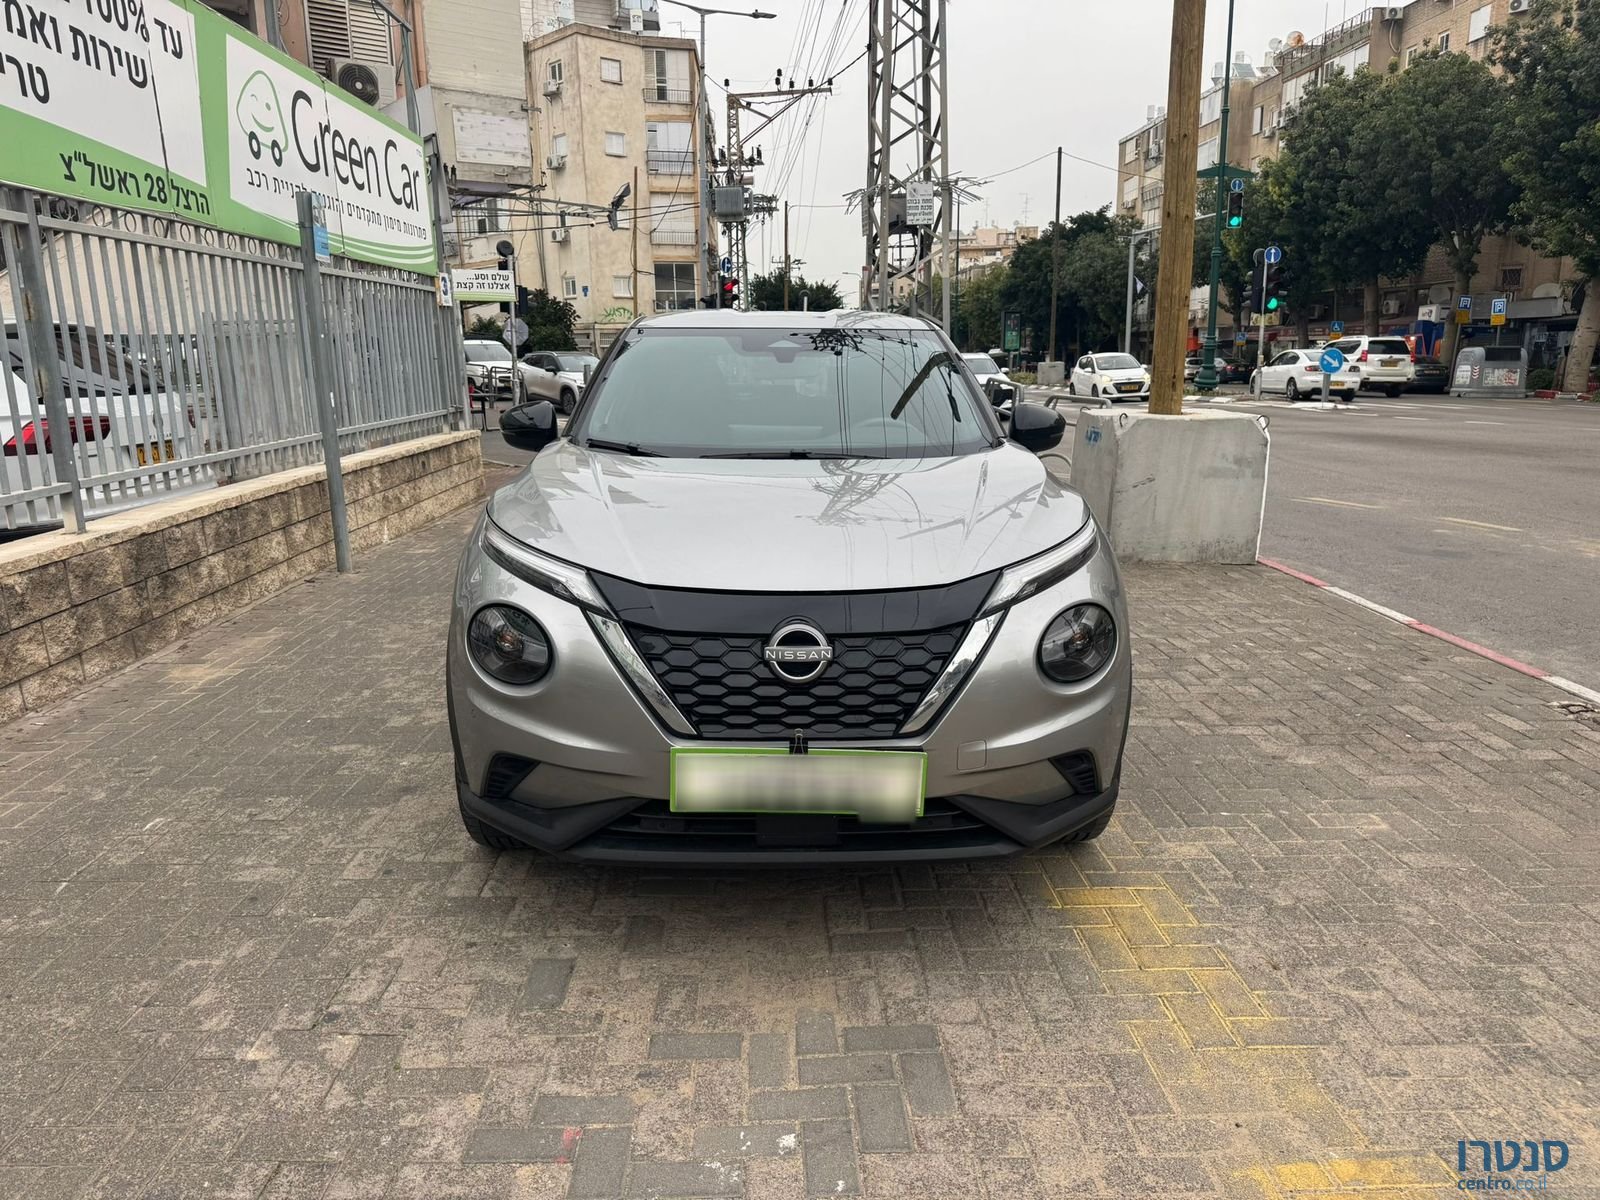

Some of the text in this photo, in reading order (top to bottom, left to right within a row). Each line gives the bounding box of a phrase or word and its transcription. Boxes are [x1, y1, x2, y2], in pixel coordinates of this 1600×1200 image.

[154, 17, 183, 60] עד
[68, 24, 148, 89] שירות
[291, 89, 420, 212] Green Car
[143, 172, 169, 205] 28
[246, 167, 270, 191] רכב
[171, 178, 211, 216] הרצל
[456, 282, 474, 291] קצת
[488, 281, 510, 290] אצלנו
[491, 272, 510, 281] שלם
[765, 650, 831, 660] NISSAN
